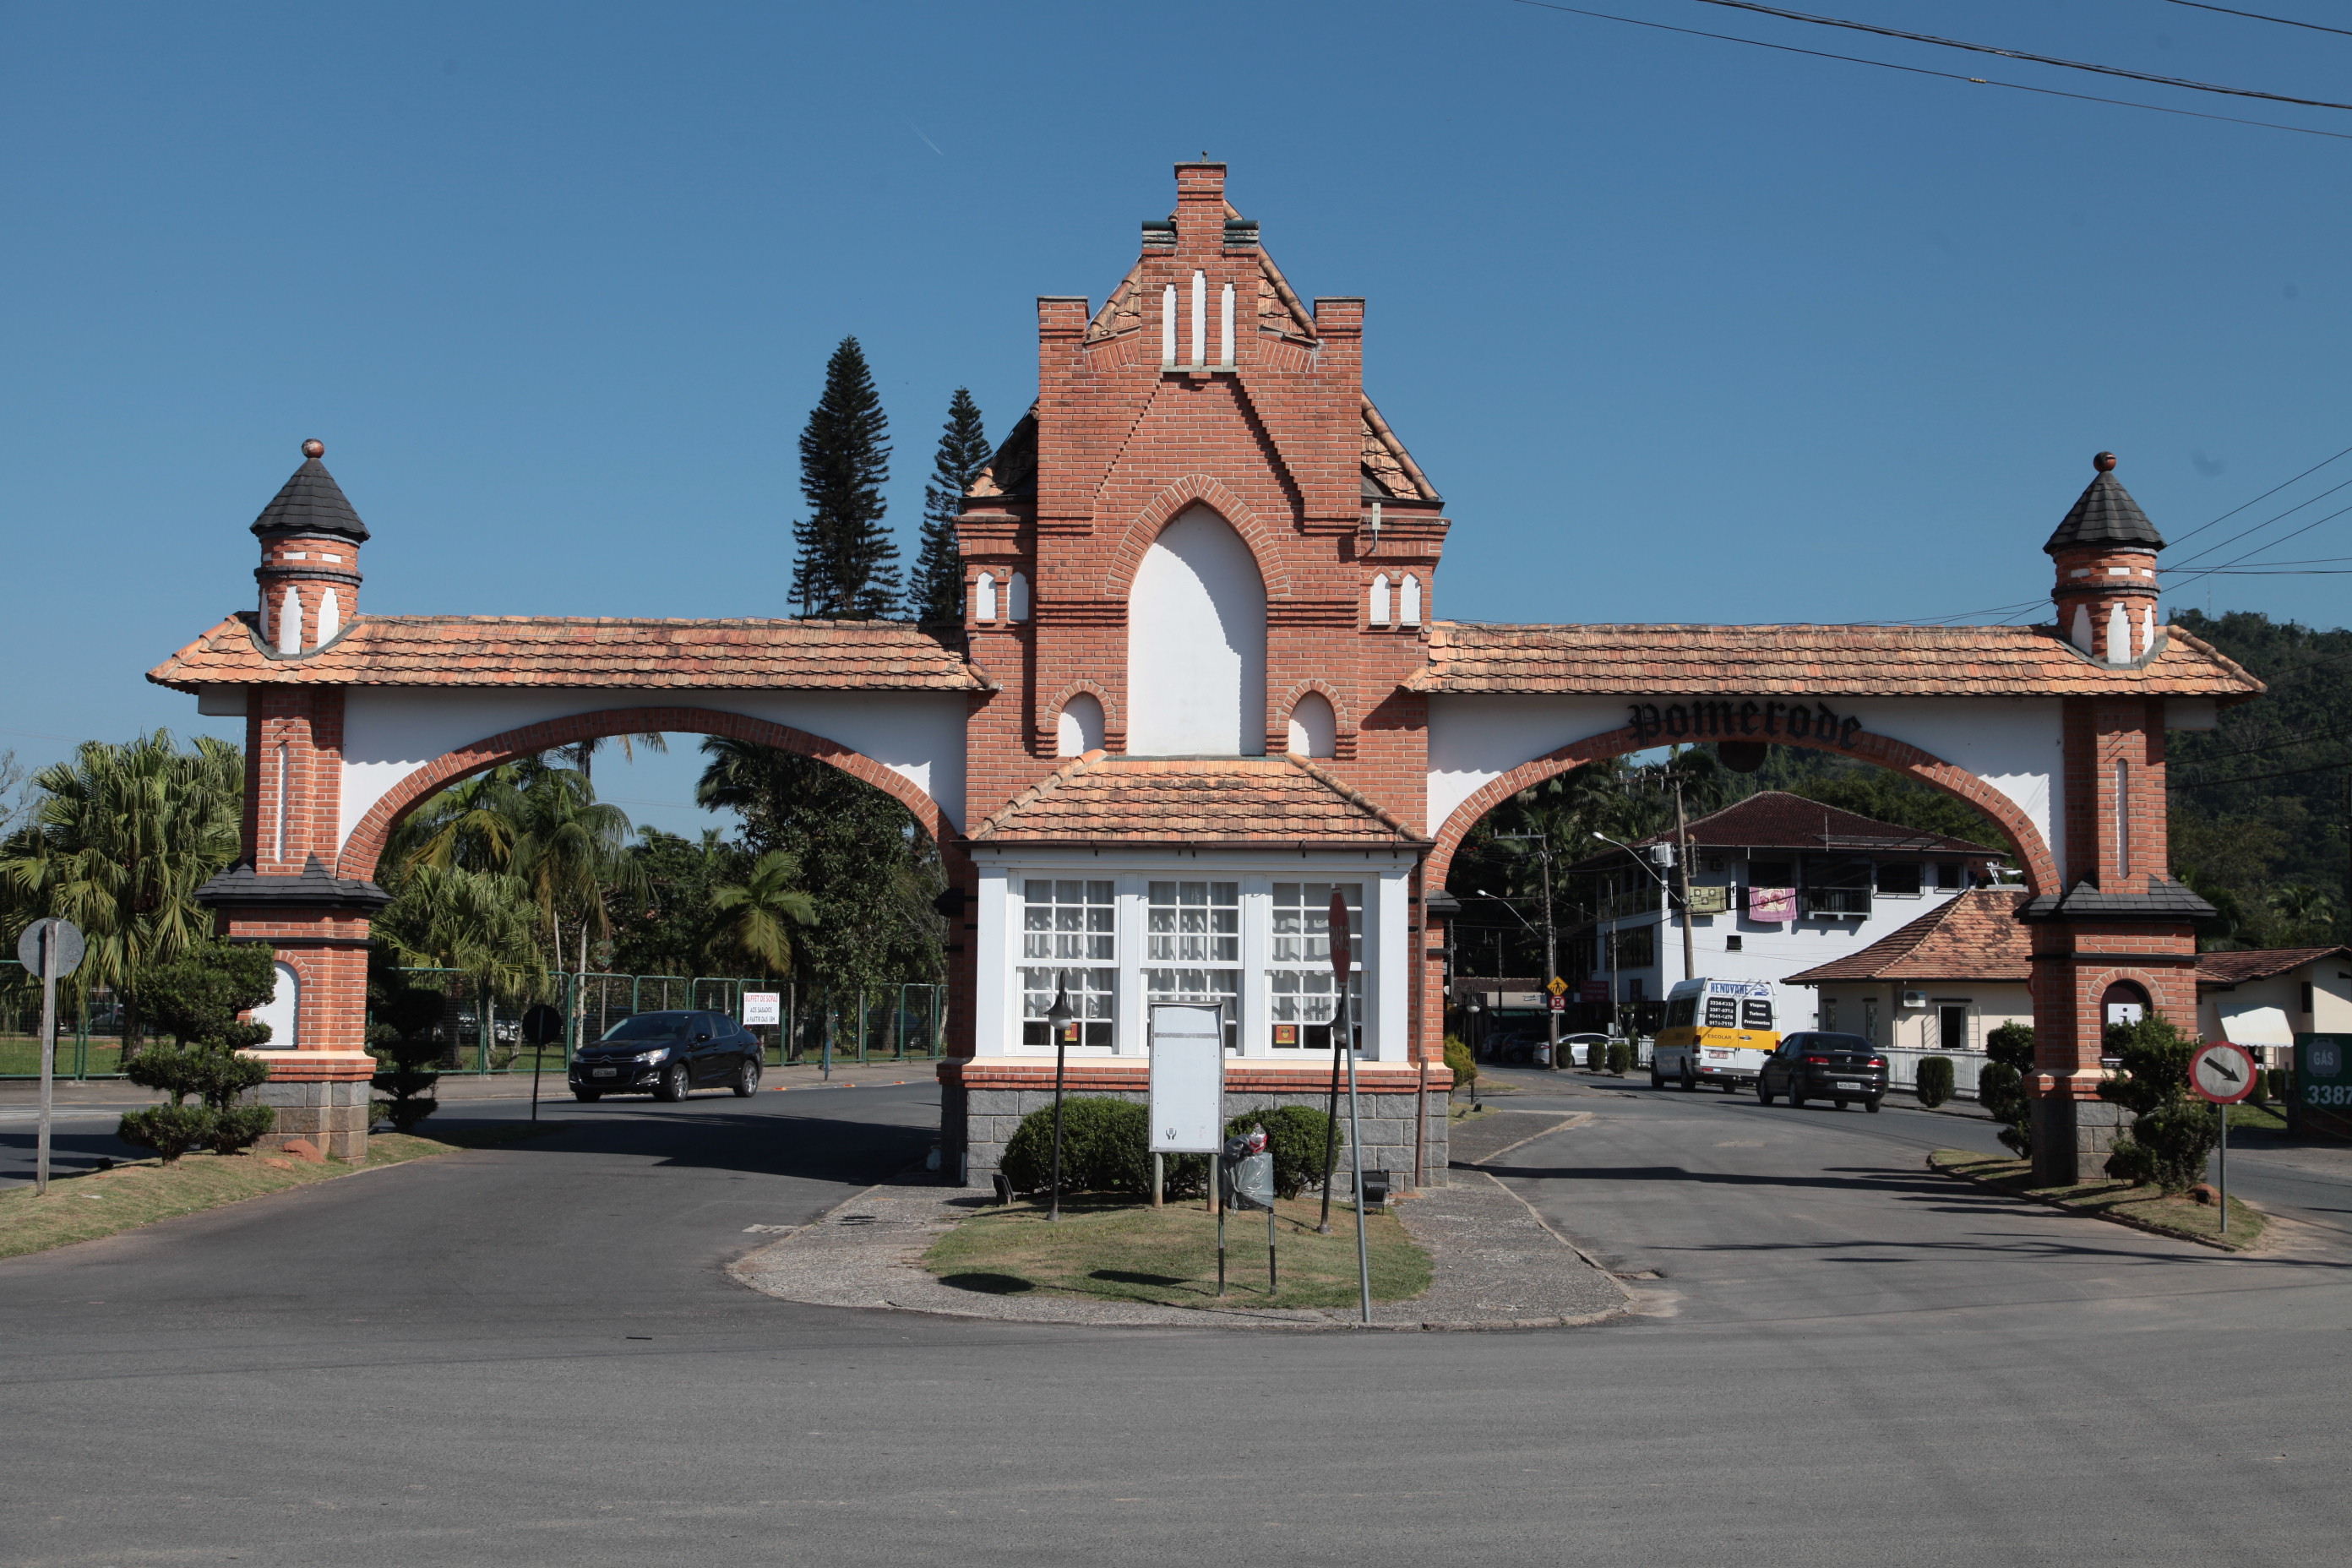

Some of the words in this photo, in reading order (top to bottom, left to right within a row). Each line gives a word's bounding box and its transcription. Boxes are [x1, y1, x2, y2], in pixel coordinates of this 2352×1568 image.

[1330, 925, 1350, 950] PARE
[2313, 1048, 2333, 1066] GÁS
[2307, 1085, 2352, 1105] 3387
